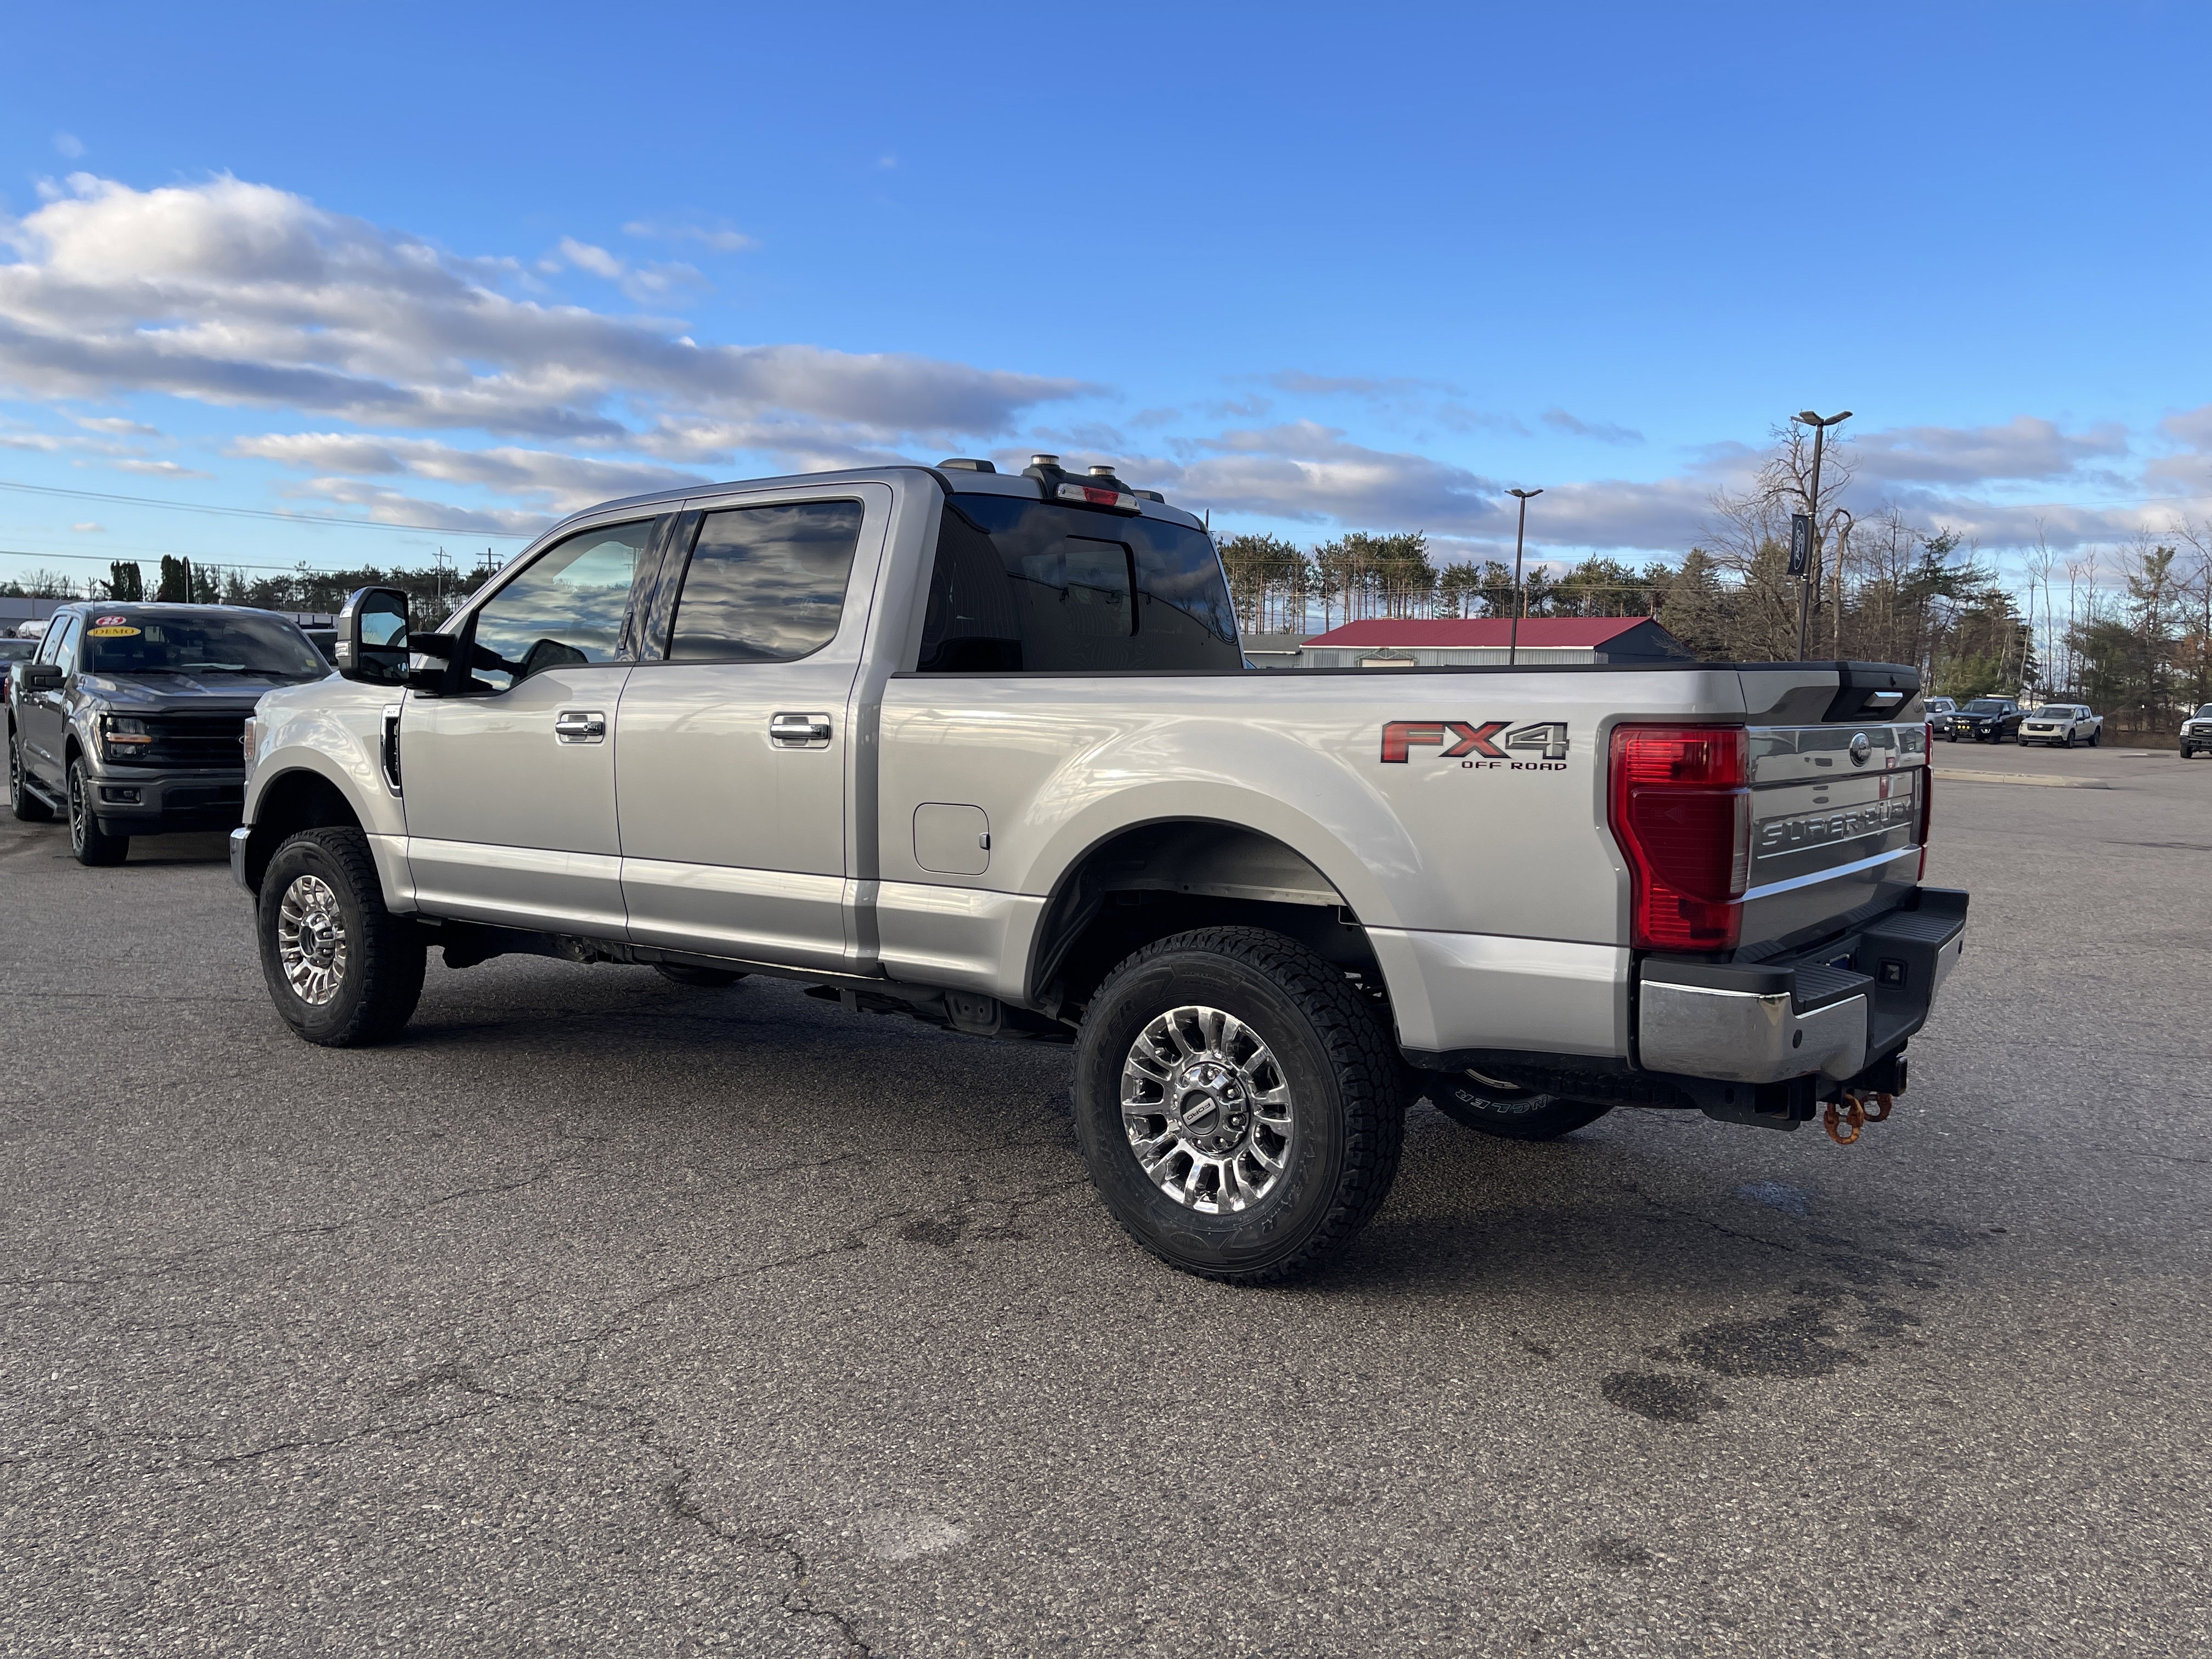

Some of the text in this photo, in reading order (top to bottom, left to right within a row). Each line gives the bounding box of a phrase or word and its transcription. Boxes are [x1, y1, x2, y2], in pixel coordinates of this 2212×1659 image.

[1795, 529, 1804, 560] Ford
[101, 616, 122, 625] 25
[1380, 720, 1570, 763] FX4
[1462, 761, 1567, 771] OFF ROAD
[1187, 1103, 1211, 1120] FORD
[1455, 1089, 1549, 1114] NGLER
